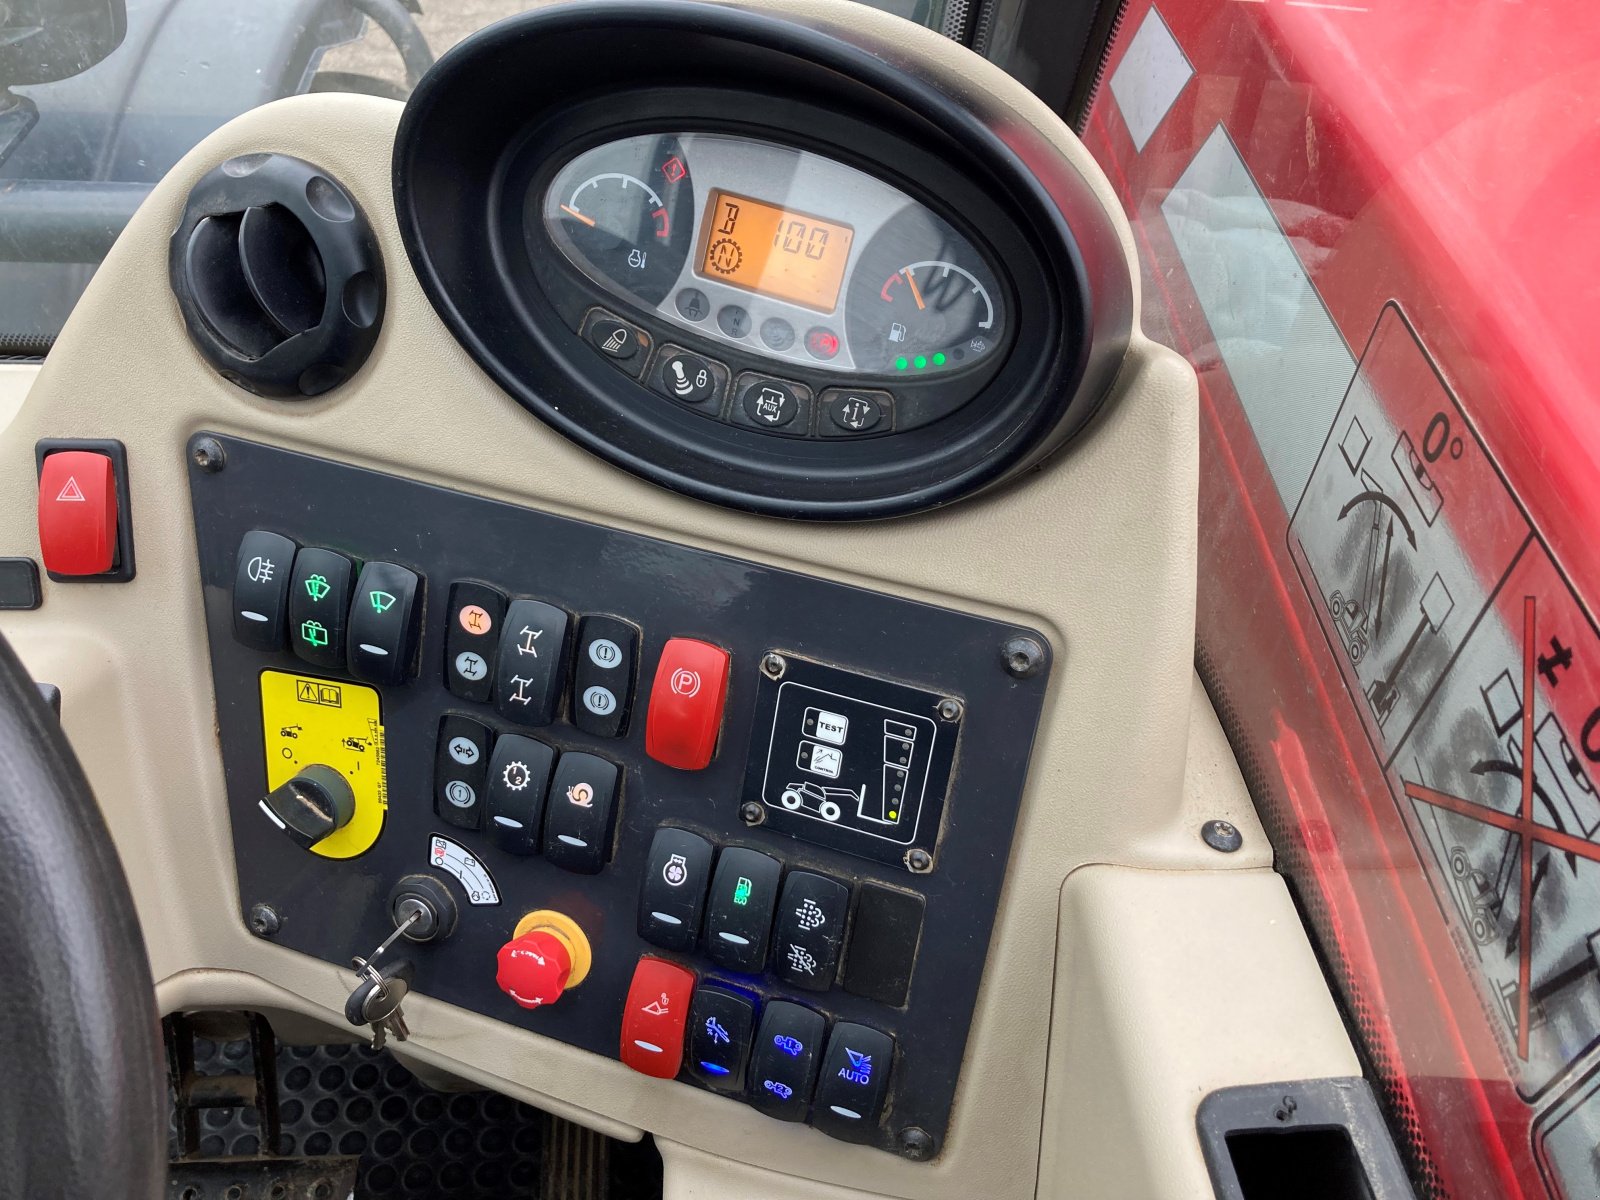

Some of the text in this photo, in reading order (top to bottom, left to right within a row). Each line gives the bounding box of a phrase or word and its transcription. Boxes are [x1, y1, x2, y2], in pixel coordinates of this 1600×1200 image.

[774, 219, 830, 261] 100
[717, 244, 735, 268] N
[762, 403, 778, 413] AUX
[678, 673, 692, 690] P
[819, 721, 843, 733] TEST
[511, 766, 517, 775] 1
[814, 765, 834, 774] CONTROL
[515, 776, 522, 785] 2
[734, 896, 747, 906] ECO
[838, 1067, 870, 1085] AUTO
